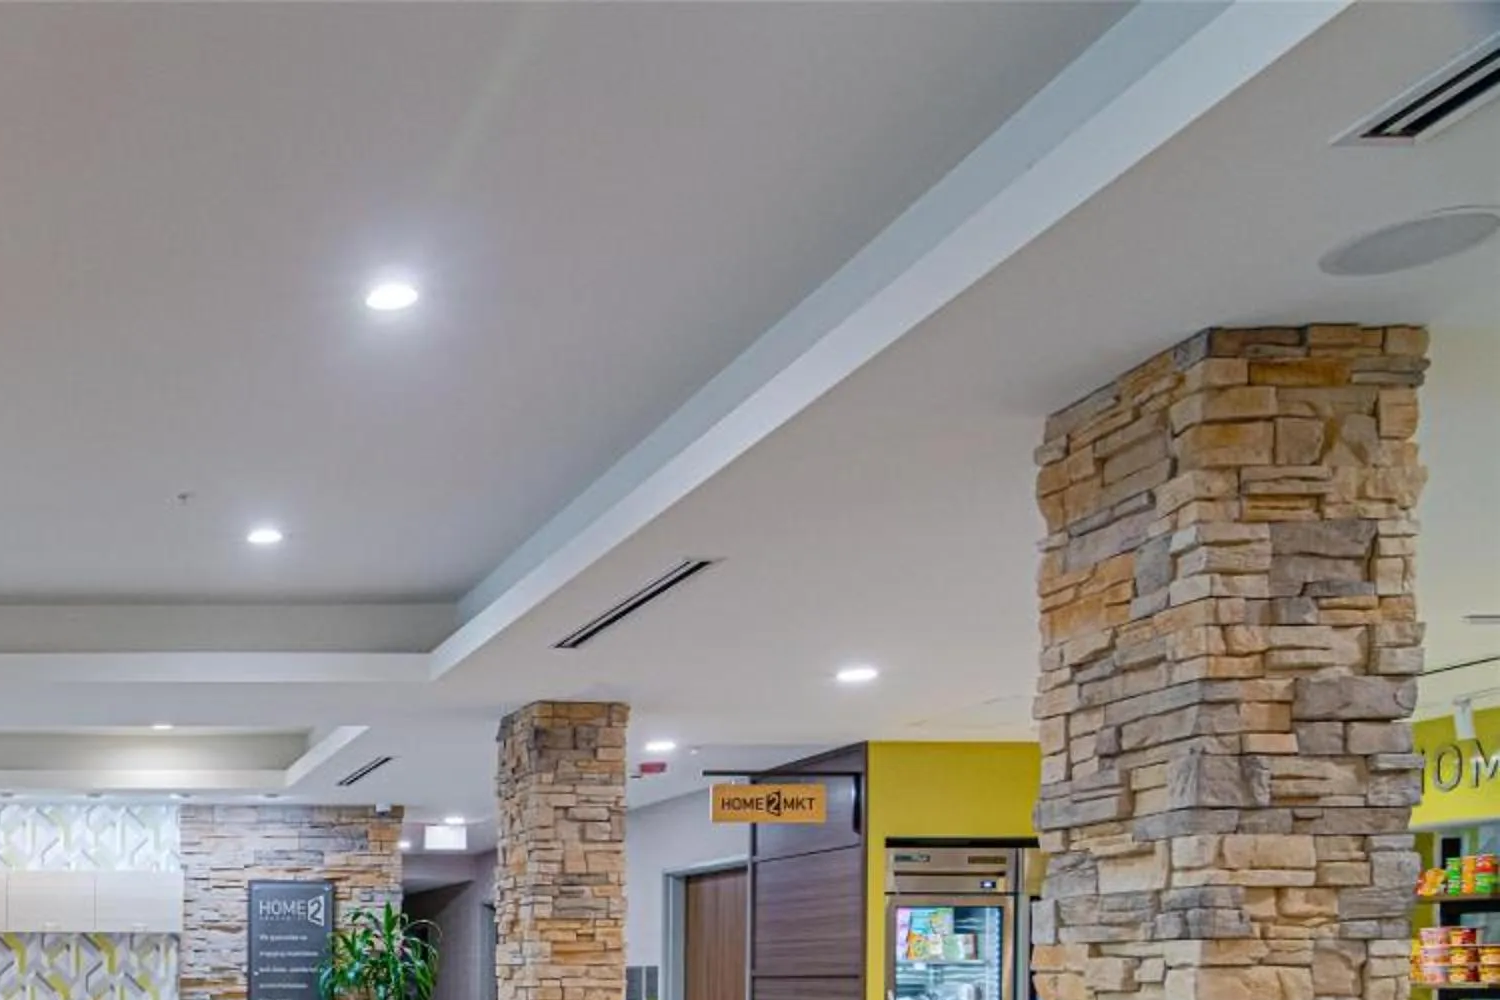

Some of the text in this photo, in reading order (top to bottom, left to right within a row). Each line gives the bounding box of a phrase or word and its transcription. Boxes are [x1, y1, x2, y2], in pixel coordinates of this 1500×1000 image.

[1420, 739, 1500, 794] OM
[721, 797, 764, 811] HOME
[783, 797, 816, 811] MKT
[259, 900, 308, 915] HOME
